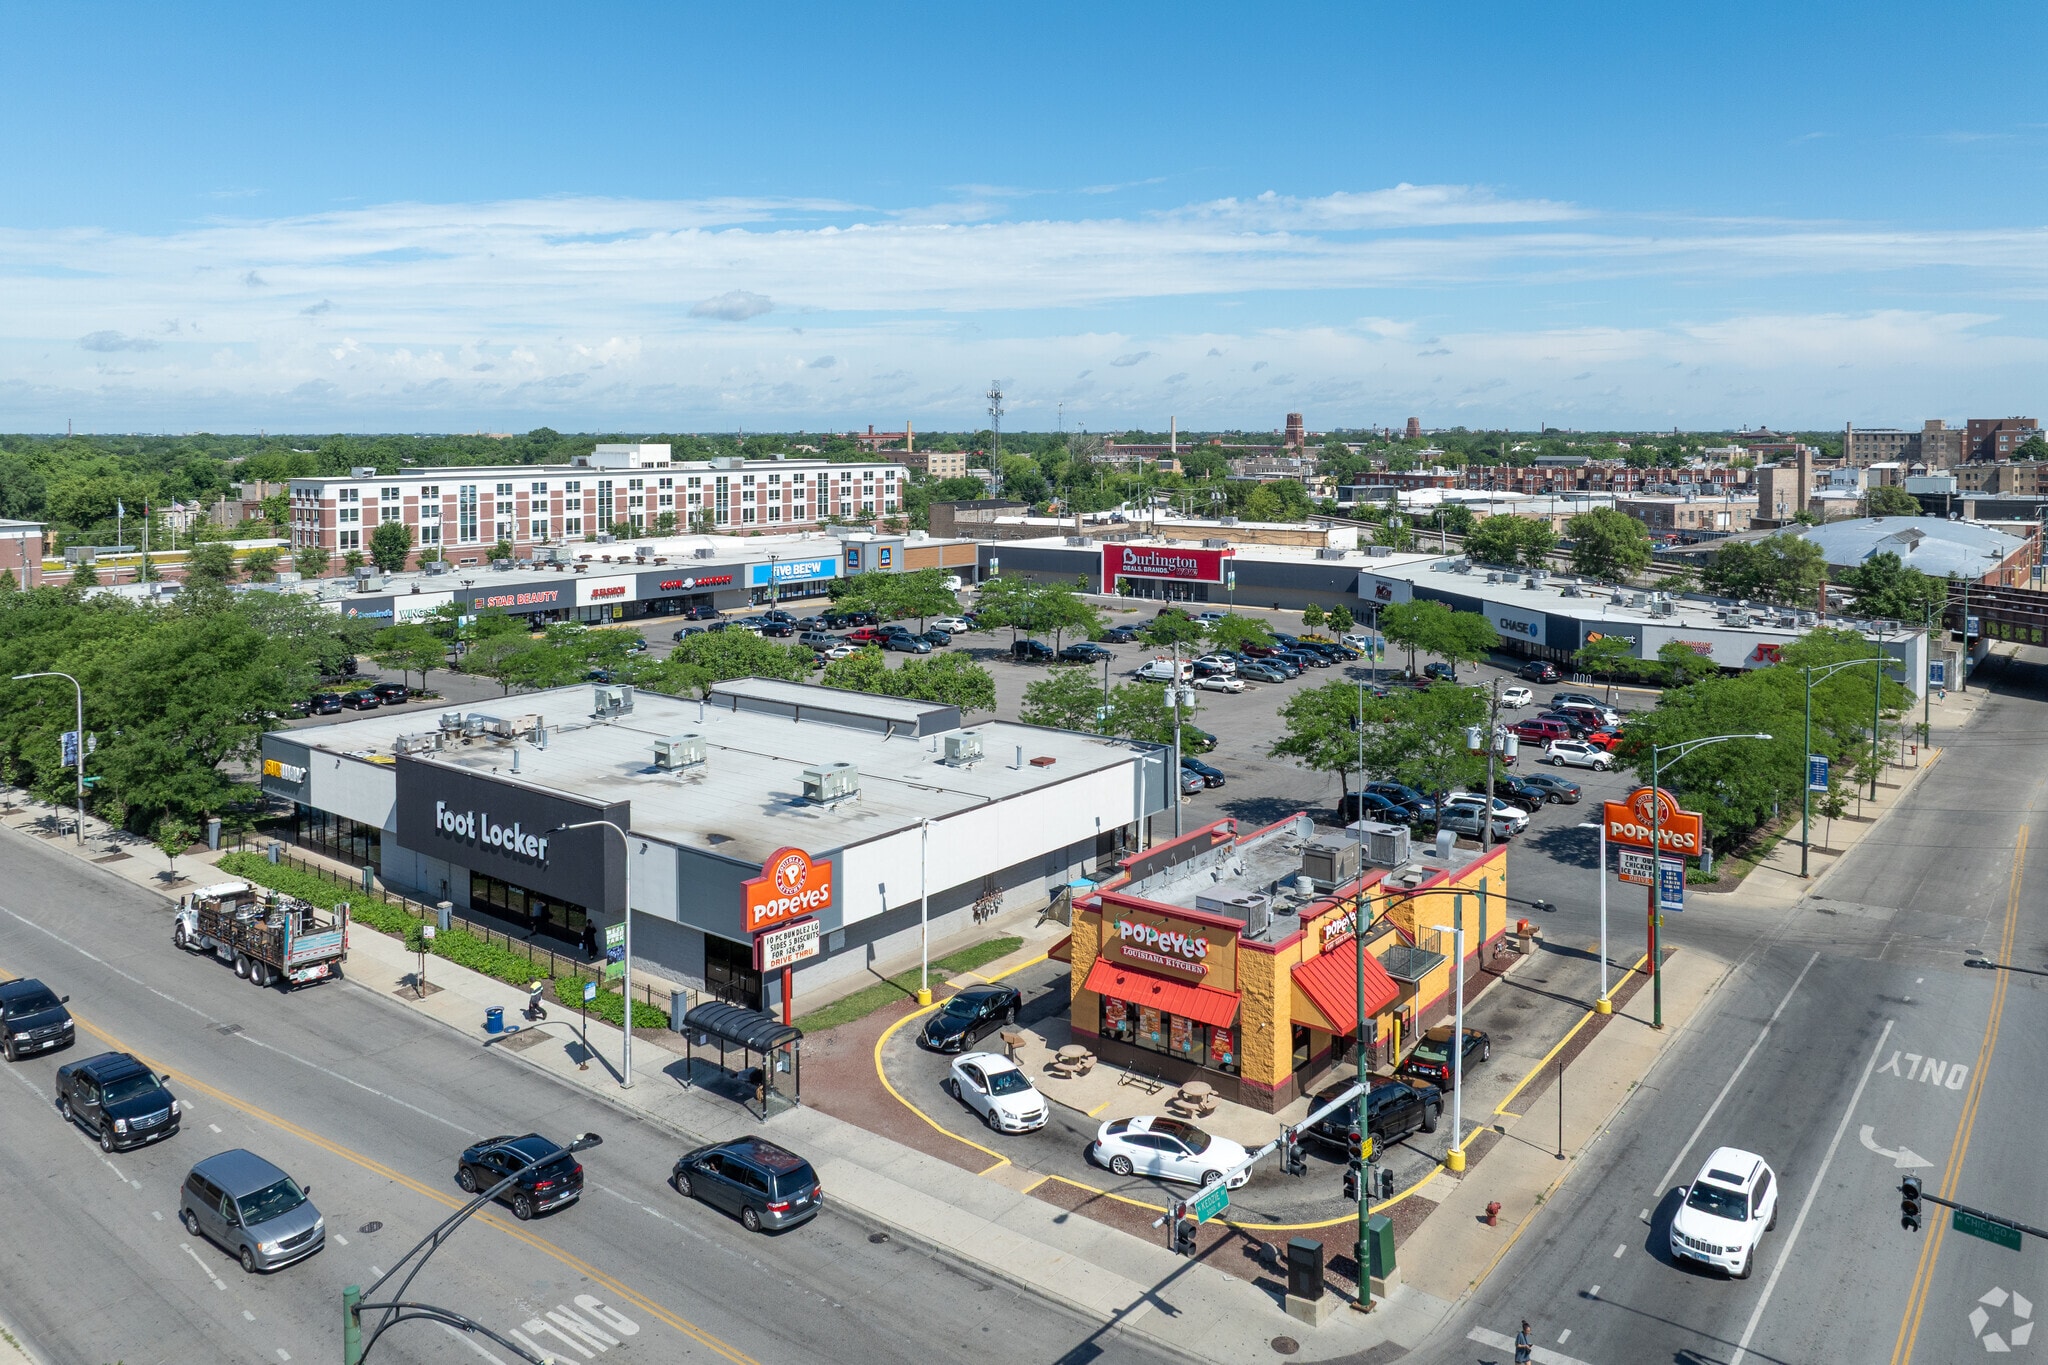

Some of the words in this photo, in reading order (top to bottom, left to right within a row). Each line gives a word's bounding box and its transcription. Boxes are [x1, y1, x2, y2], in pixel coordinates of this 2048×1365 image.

[1123, 548, 1198, 571] Burlington
[1143, 566, 1169, 574] BRANDS.
[695, 574, 733, 586] LAUNDRY
[487, 595, 514, 607] STAR
[517, 590, 558, 605] BEAUTY
[600, 585, 626, 596] FASHION
[1500, 617, 1529, 634] CHASE
[263, 759, 308, 784] SUBWAY
[436, 800, 476, 840] Foot
[481, 812, 548, 861] Locker
[776, 856, 806, 876] LOUISIANA
[1625, 854, 1638, 862] TRY
[1625, 861, 1653, 871] CHICKEN
[1633, 869, 1646, 877] BAG
[766, 936, 774, 945] 10
[775, 934, 783, 942] PC
[811, 922, 819, 931] LG
[770, 940, 787, 952] SIDES
[793, 930, 819, 945] BISCUITS
[770, 954, 793, 967] DRIVE
[795, 948, 814, 960] THRU
[772, 950, 784, 959] FOR
[1123, 948, 1164, 965] LOUISIANA
[1165, 957, 1204, 974] KITCHEN
[1876, 1050, 1969, 1090] ONLY
[1201, 1192, 1220, 1210] KEDZIE
[1965, 1217, 2007, 1237] CHICAGO
[2008, 1232, 2018, 1240] AV
[1974, 1229, 1990, 1239] 800
[509, 1294, 640, 1365] ONLY
